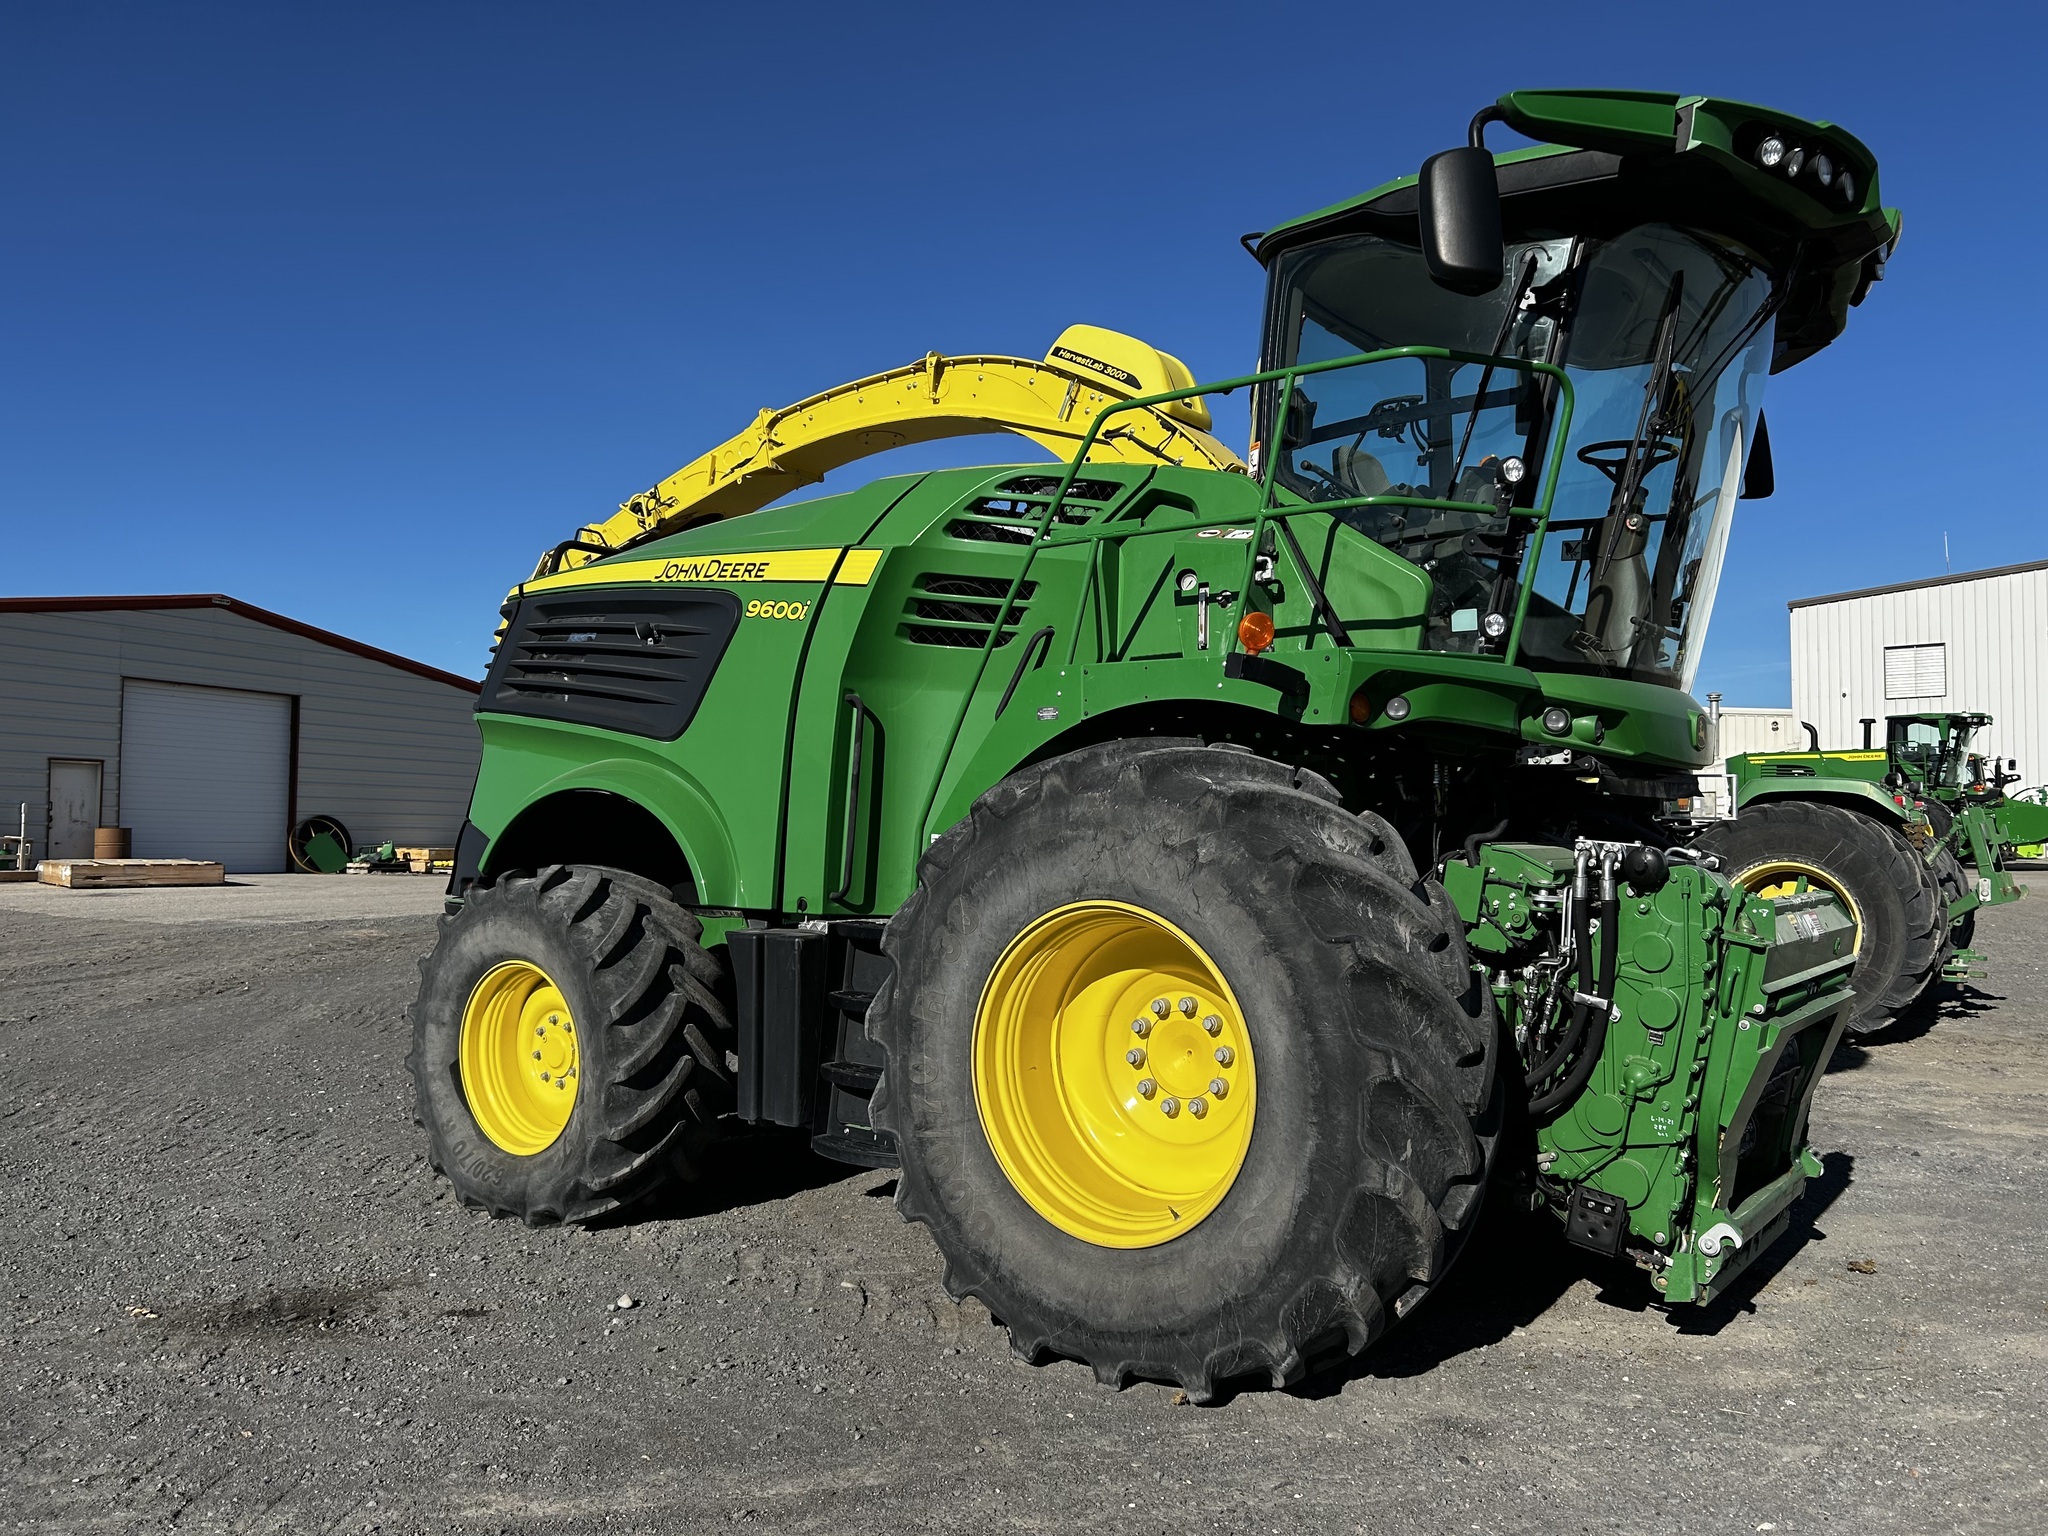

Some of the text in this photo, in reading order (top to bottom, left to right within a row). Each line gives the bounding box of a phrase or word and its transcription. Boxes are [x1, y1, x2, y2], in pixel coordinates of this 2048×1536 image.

[1057, 348, 1128, 381] HarvestLab 3000
[654, 559, 770, 580] JOHN DEERE
[745, 599, 812, 621] 9600i
